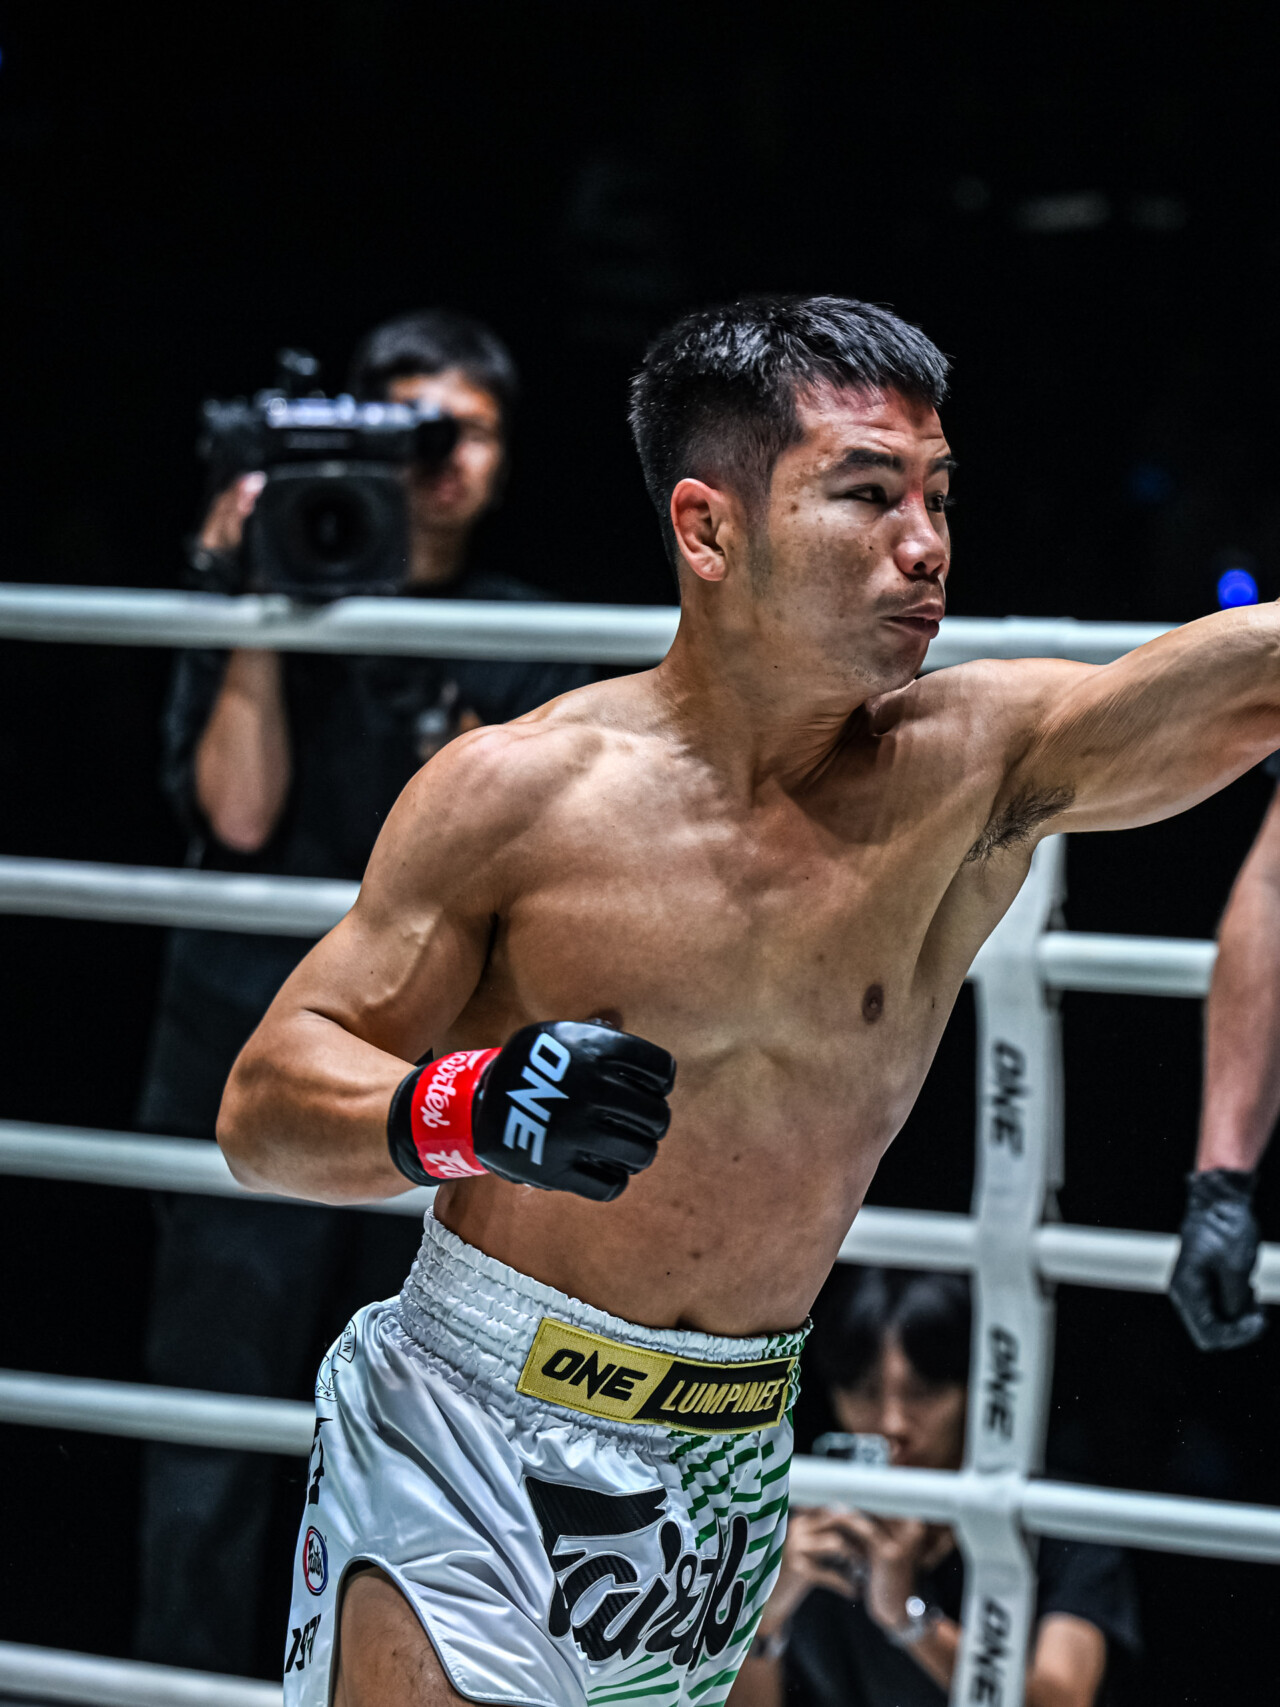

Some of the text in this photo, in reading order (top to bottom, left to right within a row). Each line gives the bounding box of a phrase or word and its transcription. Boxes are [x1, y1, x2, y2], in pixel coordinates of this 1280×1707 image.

[502, 1032, 571, 1166] ONE
[991, 1041, 1027, 1157] ONE
[541, 1348, 787, 1414] ONE LUMPINEE
[986, 1325, 1022, 1441] ONE
